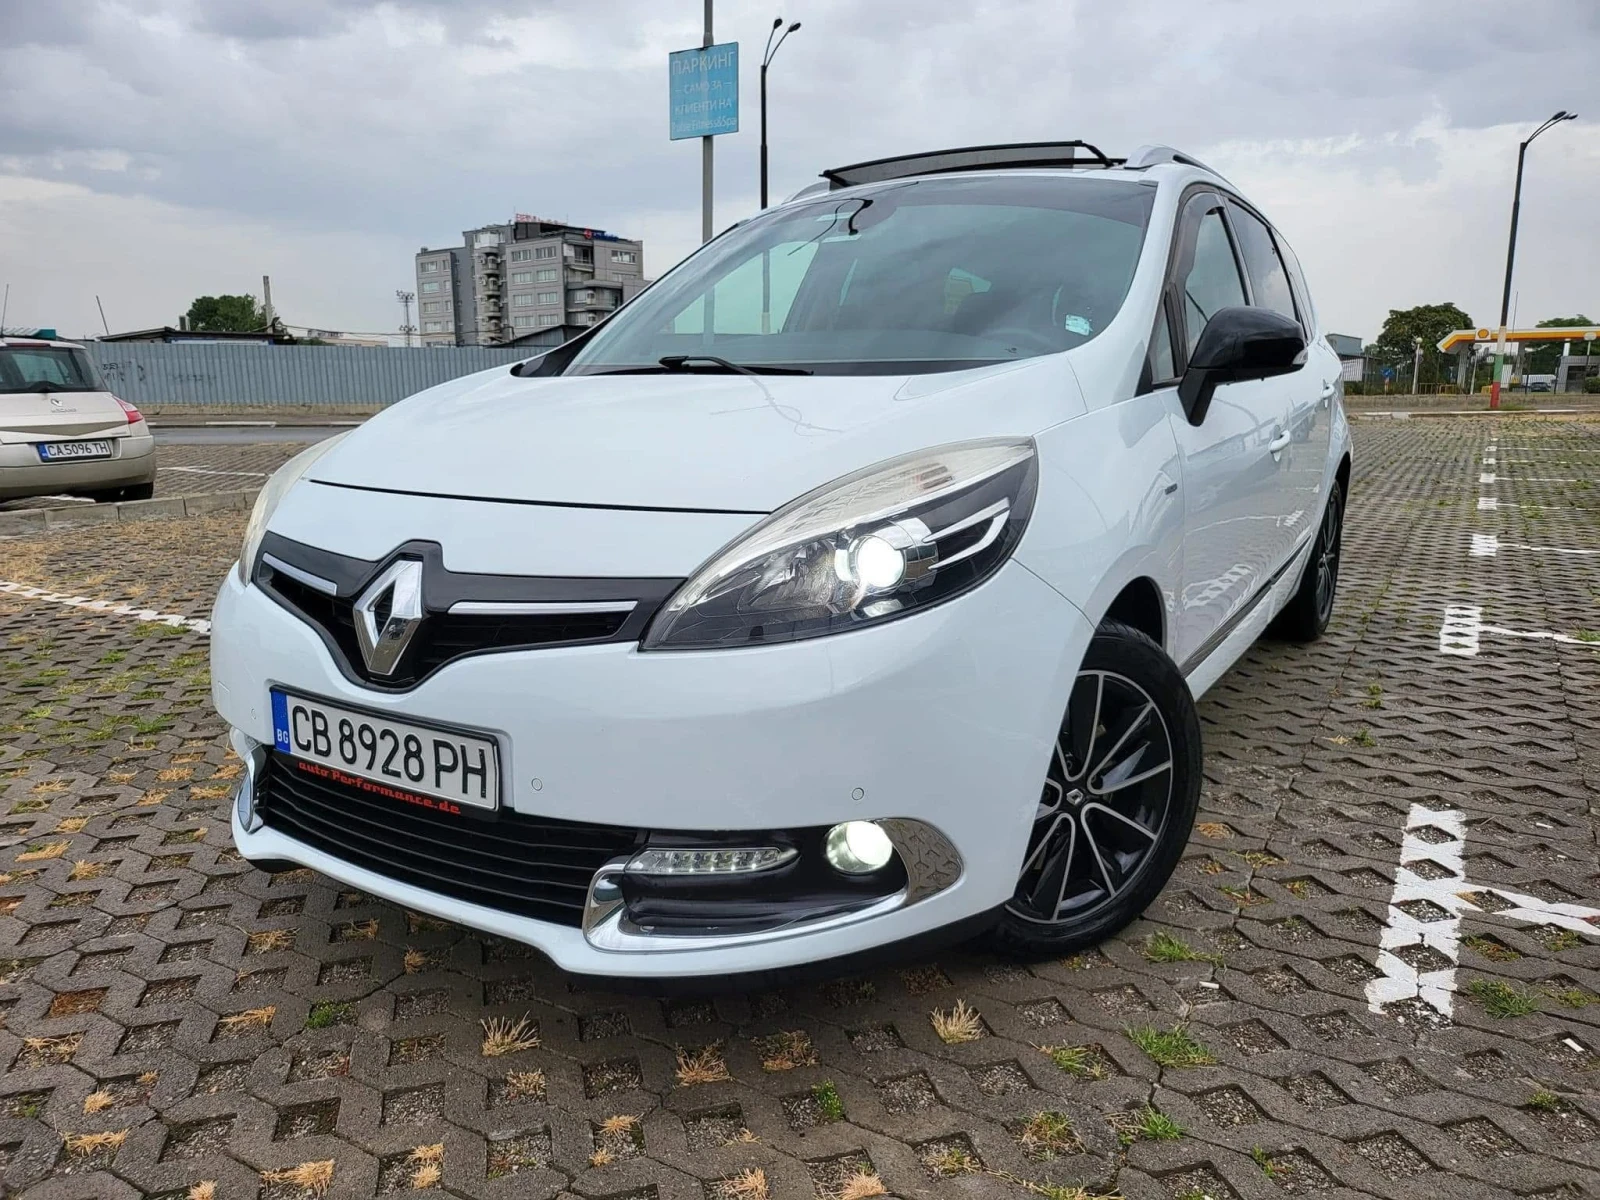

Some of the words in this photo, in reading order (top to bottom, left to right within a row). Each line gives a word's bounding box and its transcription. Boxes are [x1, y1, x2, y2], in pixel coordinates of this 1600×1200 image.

[672, 51, 736, 75] ПАРКИНГ
[718, 97, 732, 110] НА
[47, 445, 65, 456] CA
[63, 443, 92, 455] 5096
[92, 442, 108, 453] TH
[277, 728, 289, 744] BG
[292, 705, 331, 757] CB
[338, 718, 424, 783] 8928
[433, 738, 487, 798] PH
[298, 762, 328, 778] auto
[331, 769, 461, 815] Performance.de
